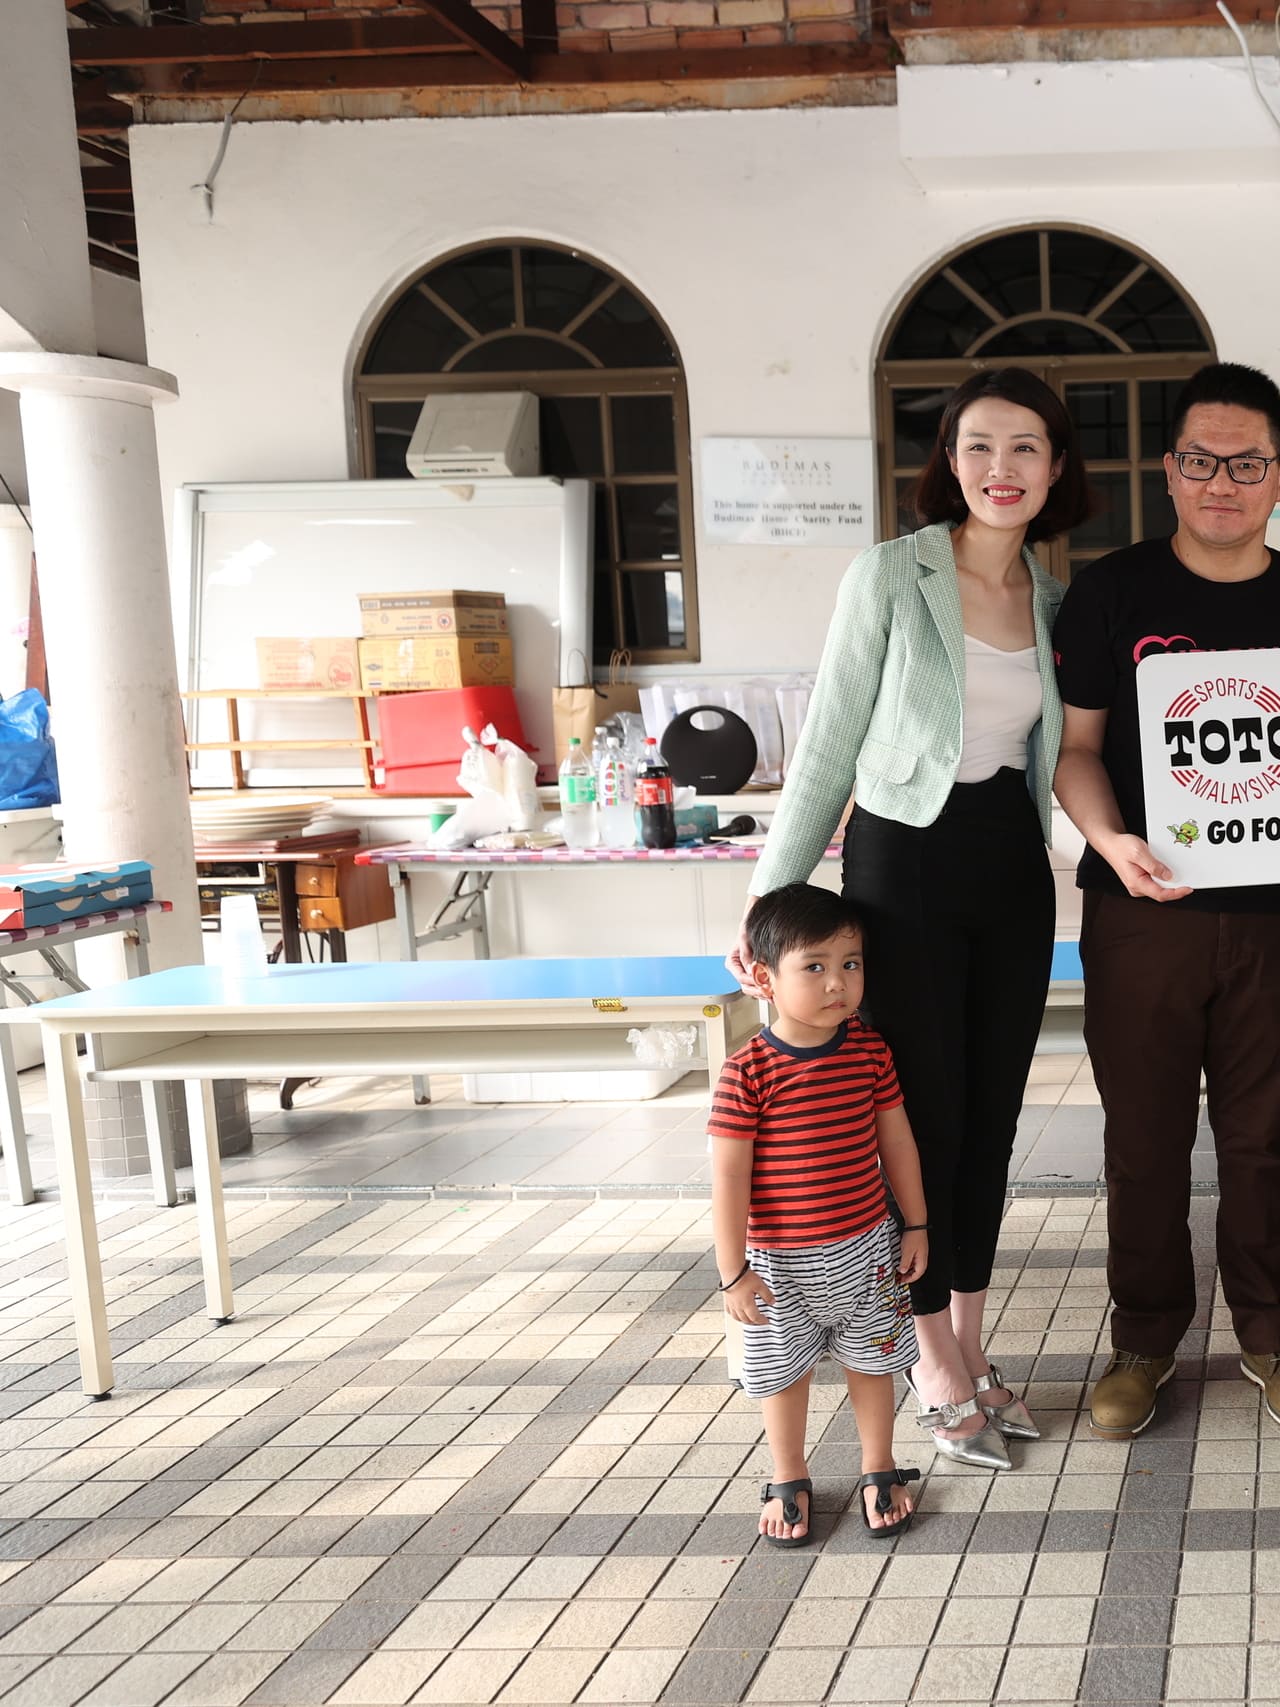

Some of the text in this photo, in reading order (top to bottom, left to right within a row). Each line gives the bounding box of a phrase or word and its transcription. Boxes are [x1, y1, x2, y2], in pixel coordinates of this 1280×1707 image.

[773, 502, 816, 512] supported
[820, 502, 844, 511] under
[849, 502, 863, 511] the
[795, 515, 831, 525] Charity
[838, 515, 863, 524] Fund
[1194, 678, 1258, 702] SPORTS
[1190, 772, 1280, 804] MALAYSIA
[1207, 820, 1245, 845] GO
